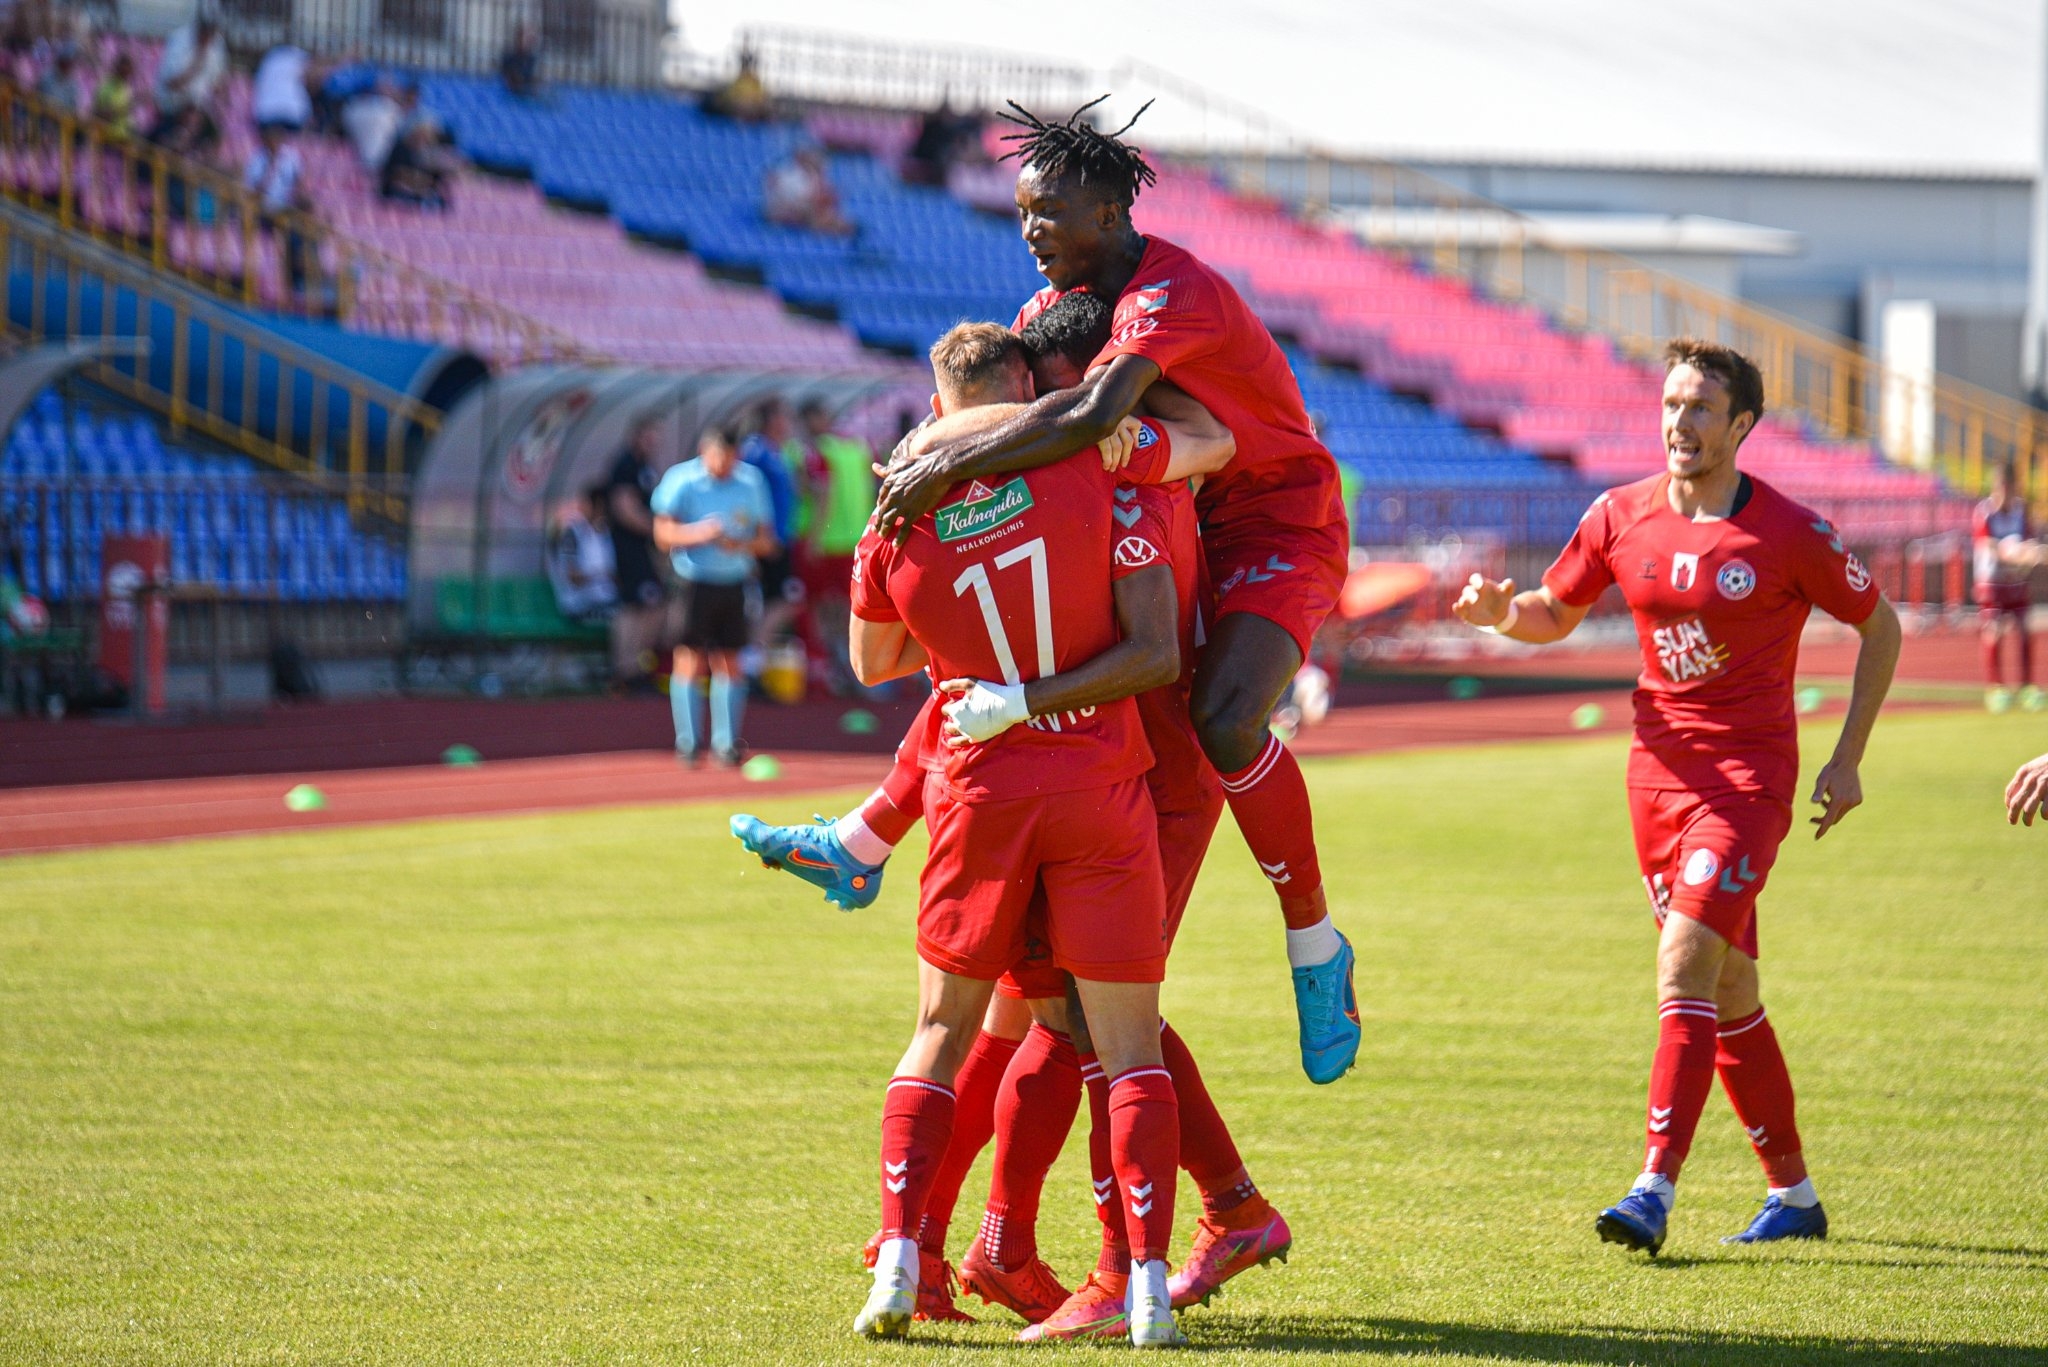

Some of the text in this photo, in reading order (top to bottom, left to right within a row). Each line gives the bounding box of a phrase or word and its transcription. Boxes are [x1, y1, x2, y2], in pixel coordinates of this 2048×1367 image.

[944, 489, 1024, 536] Kalnapilis
[956, 519, 1025, 554] NEALKOHOLINIS
[952, 536, 1056, 687] 17
[1653, 619, 1708, 657] SUN
[1661, 644, 1720, 683] YAN
